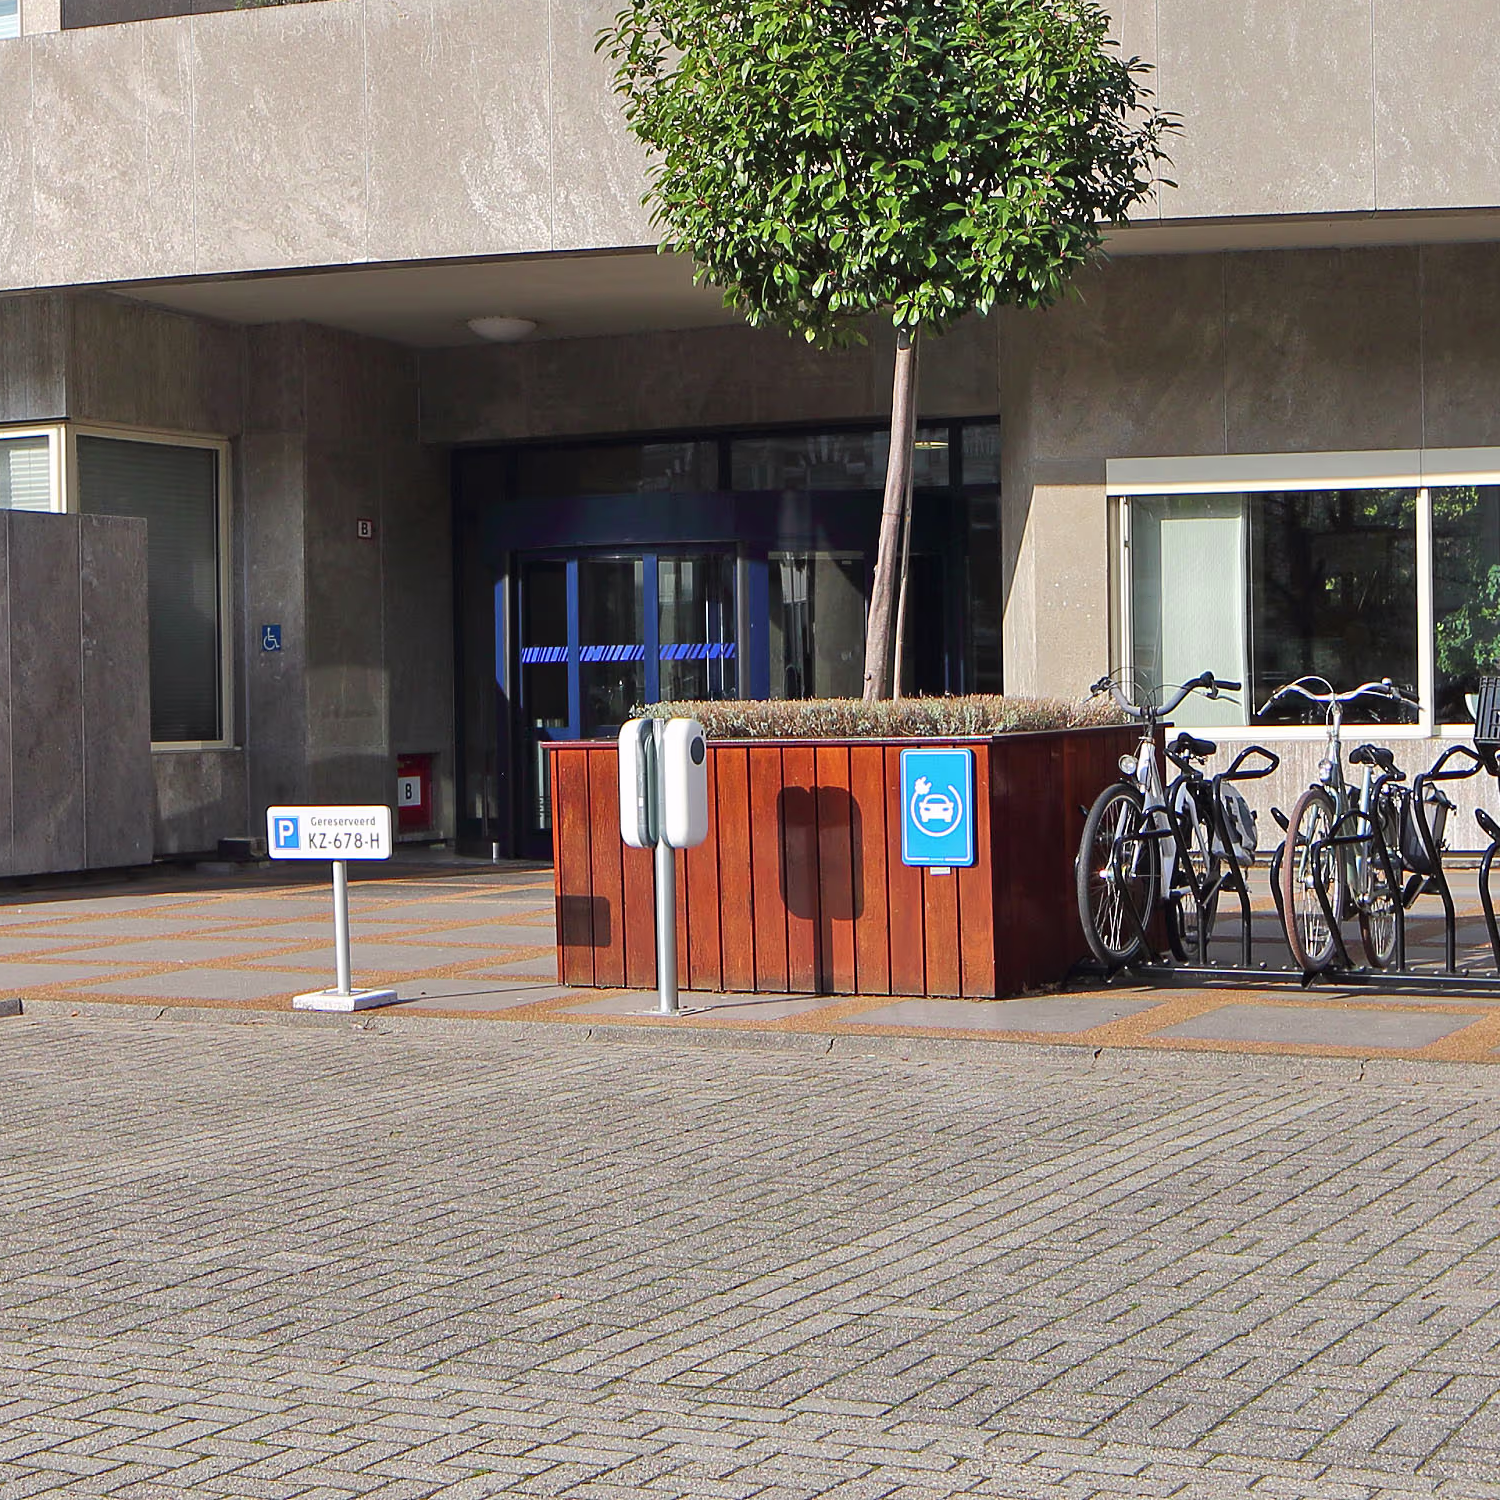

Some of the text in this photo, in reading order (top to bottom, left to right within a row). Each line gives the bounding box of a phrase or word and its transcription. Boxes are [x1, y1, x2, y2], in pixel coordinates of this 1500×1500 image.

[361, 522, 368, 535] B
[278, 816, 376, 846] P Gereserveerd
[308, 832, 380, 850] KZ-678-H
